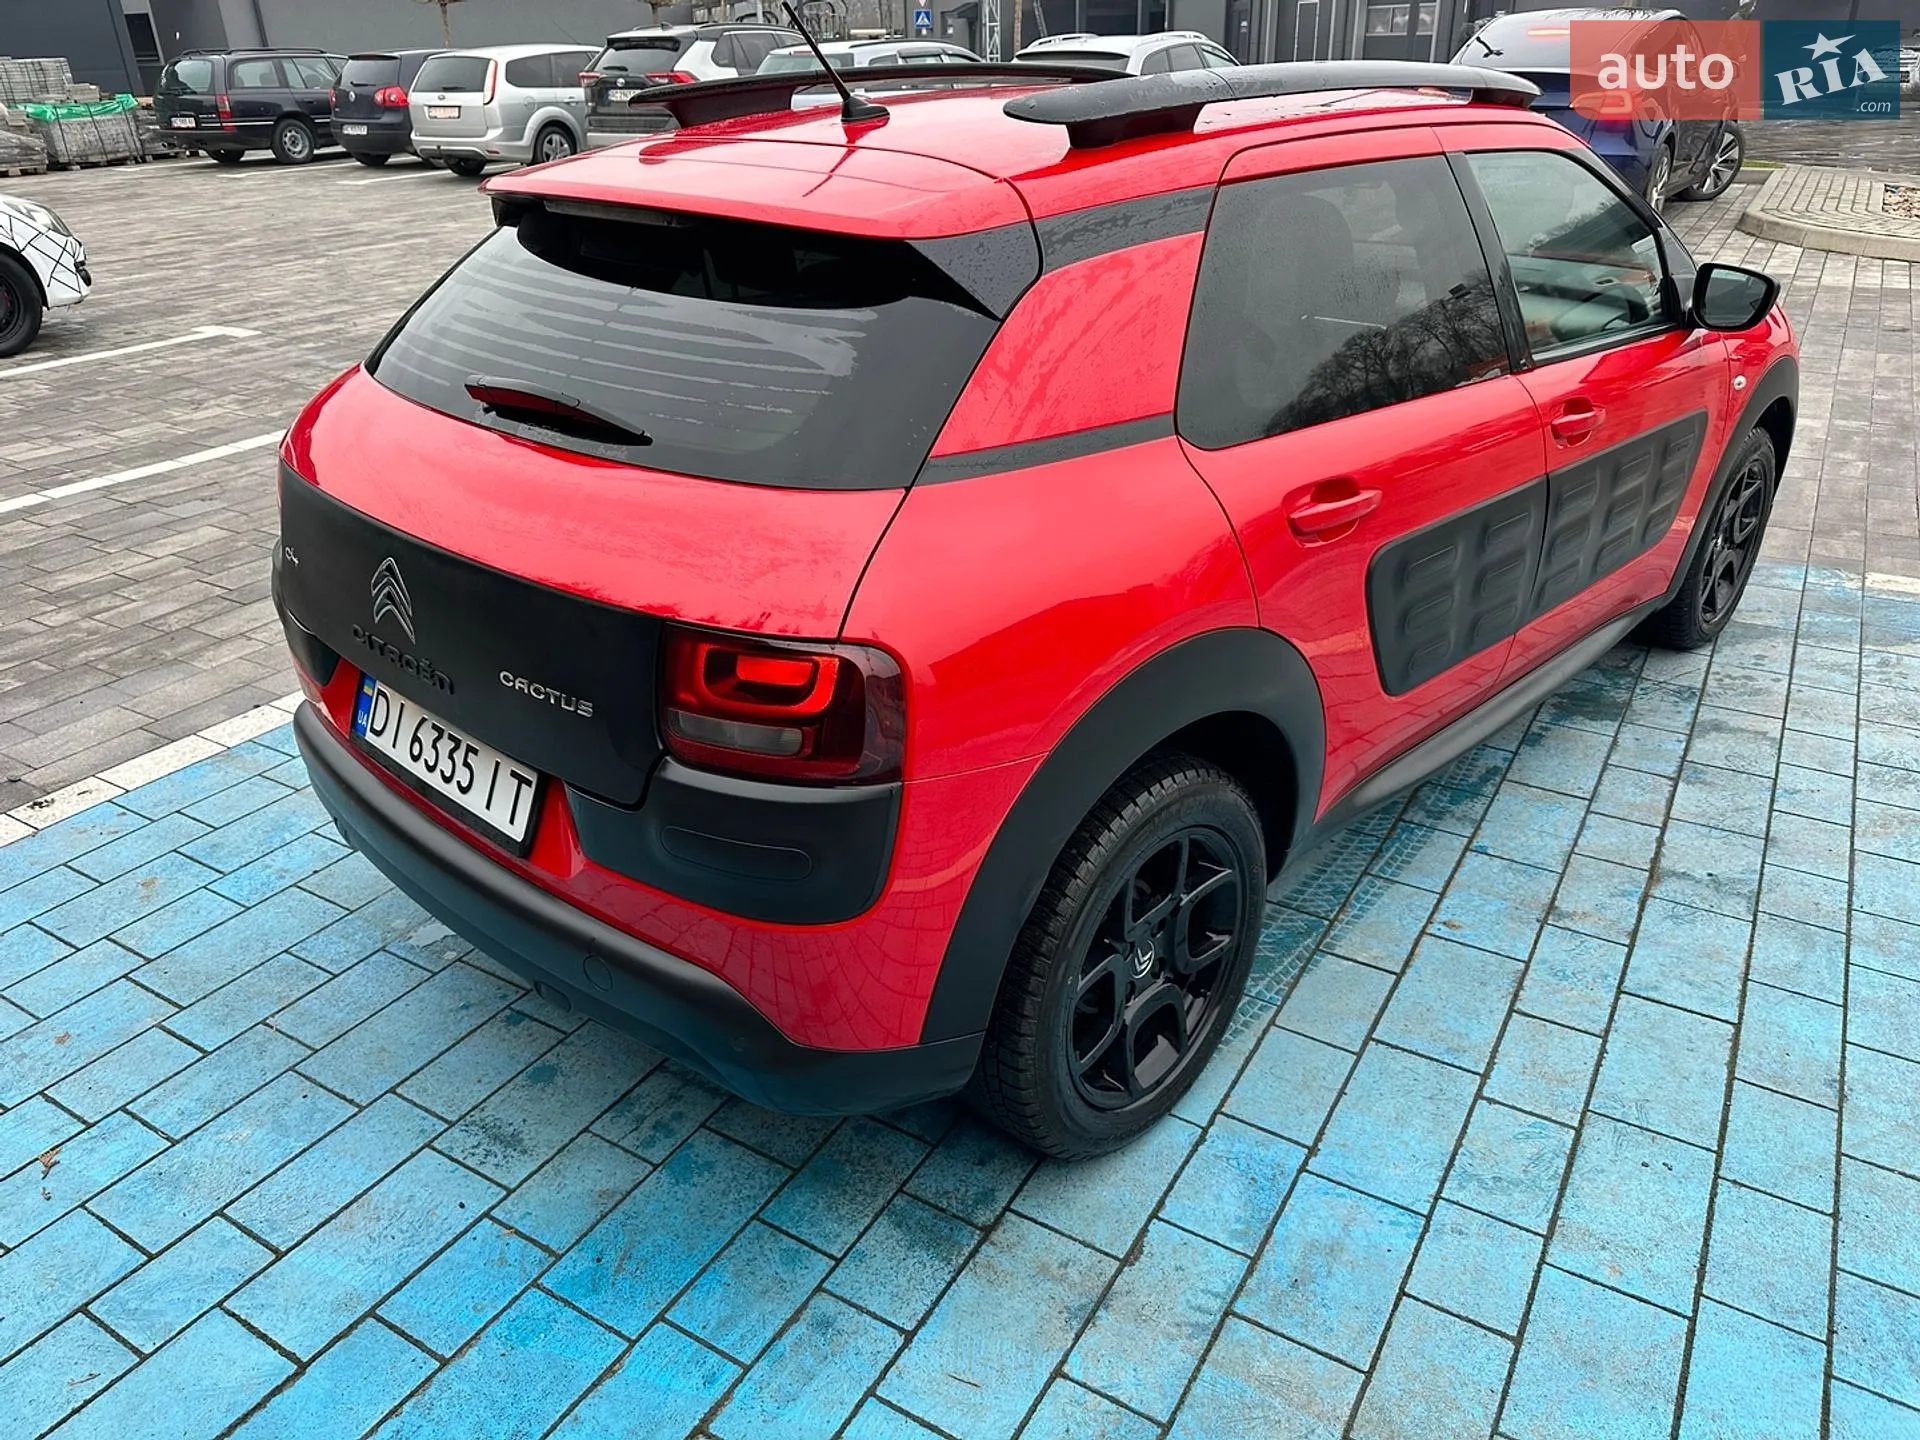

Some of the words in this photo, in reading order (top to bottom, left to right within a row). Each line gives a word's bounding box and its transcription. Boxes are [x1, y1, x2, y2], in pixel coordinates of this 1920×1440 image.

[499, 669, 595, 718] CACTUS
[357, 711, 368, 728] UA
[369, 687, 406, 750] DI
[409, 716, 480, 795] 6335
[485, 759, 533, 826] IT
